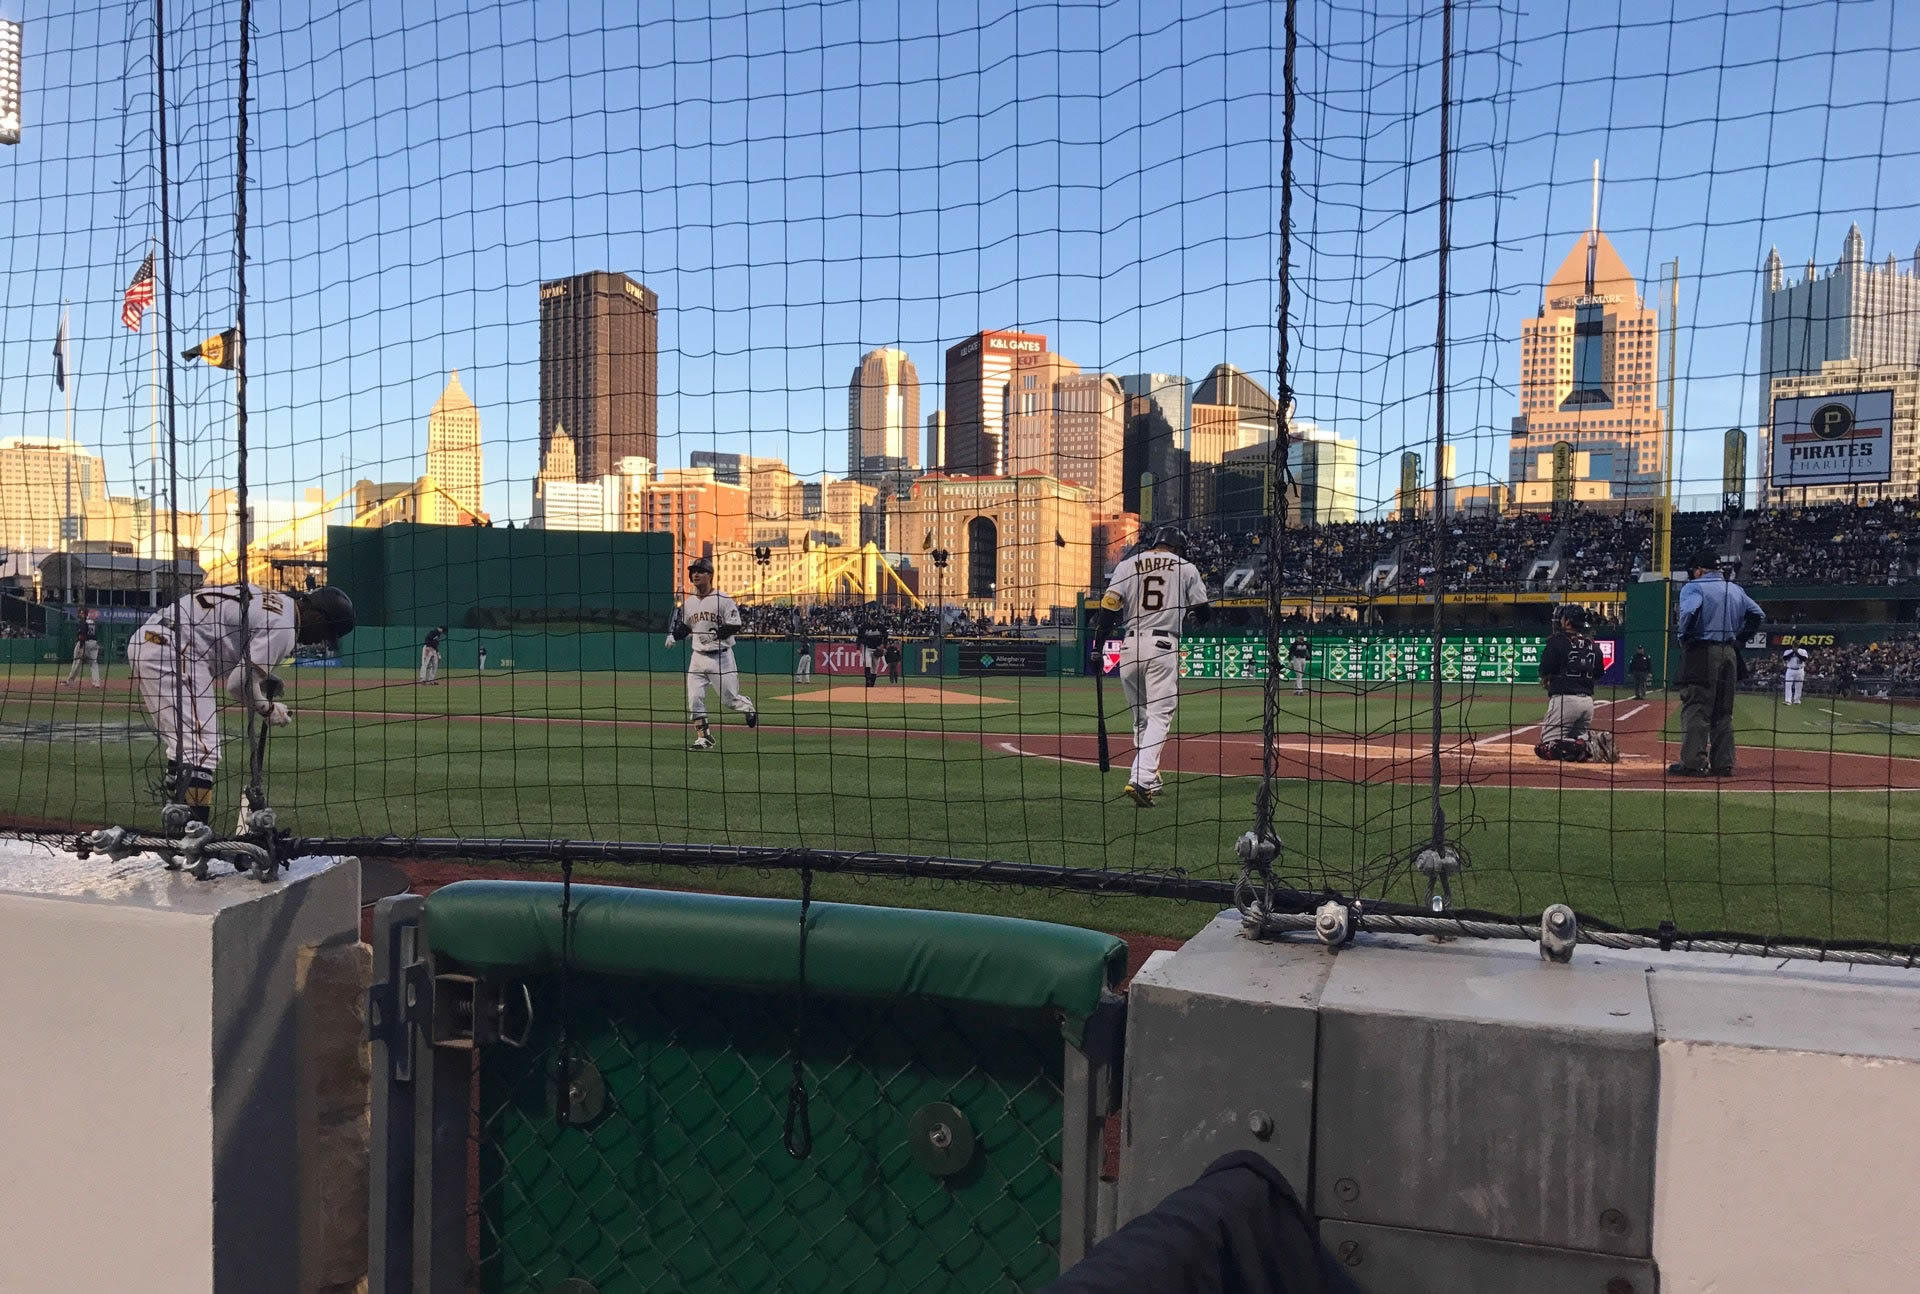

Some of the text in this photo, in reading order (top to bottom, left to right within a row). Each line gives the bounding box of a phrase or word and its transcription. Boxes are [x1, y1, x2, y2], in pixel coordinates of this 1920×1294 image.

[541, 284, 567, 300] UPMC
[625, 281, 644, 301] UPMC
[990, 339, 1040, 352] K&L GATES
[1017, 355, 1039, 365] EQT
[1790, 442, 1873, 460] PIRATES
[1790, 458, 1873, 471] CHARITIES
[1134, 557, 1177, 574] MARTE
[1142, 575, 1165, 611] 6
[1475, 594, 1498, 602] Health
[688, 611, 723, 626] PIRATES
[821, 646, 889, 673] xfiny
[920, 648, 939, 673] P
